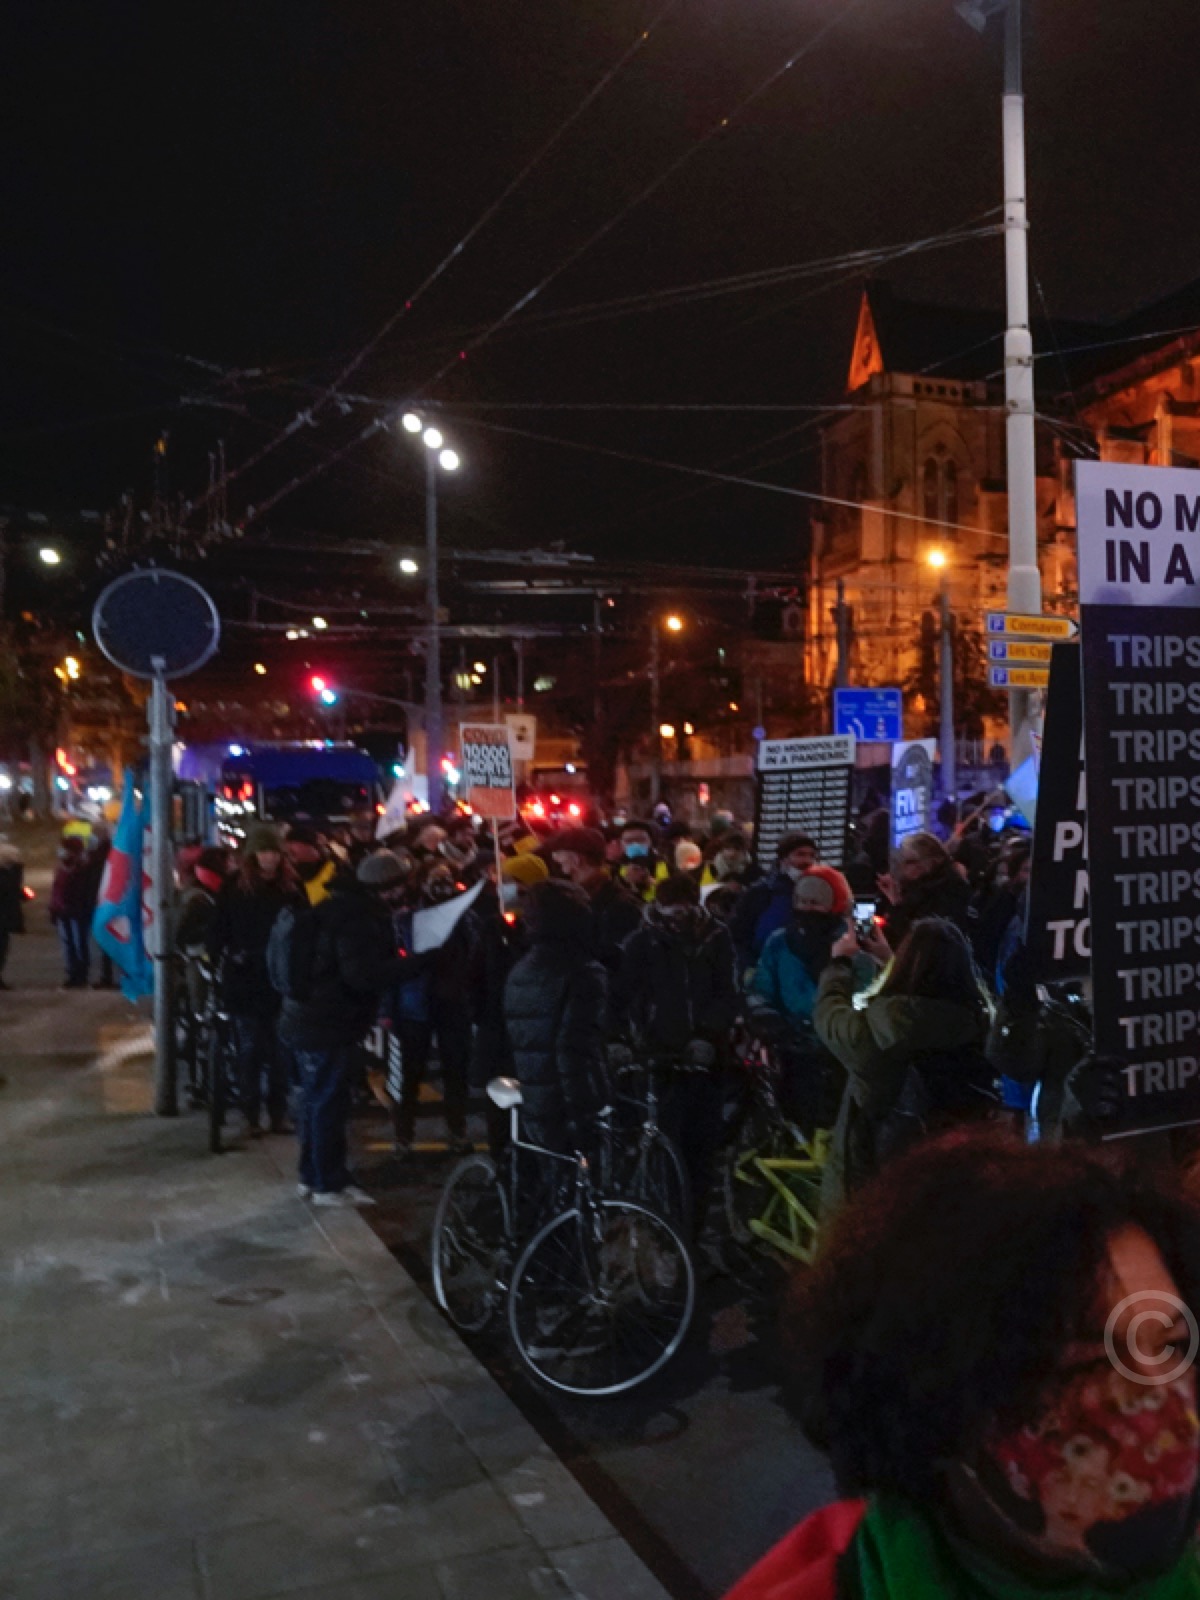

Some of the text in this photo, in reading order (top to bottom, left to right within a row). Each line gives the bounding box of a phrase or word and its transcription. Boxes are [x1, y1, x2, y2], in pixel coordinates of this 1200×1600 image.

[1105, 488, 1162, 531] NO
[1105, 540, 1151, 583] IN
[1164, 544, 1195, 585] A
[1011, 617, 1063, 633] Cornavin
[784, 740, 849, 753] MONOPOLIES
[791, 750, 849, 763] PANDEMIC
